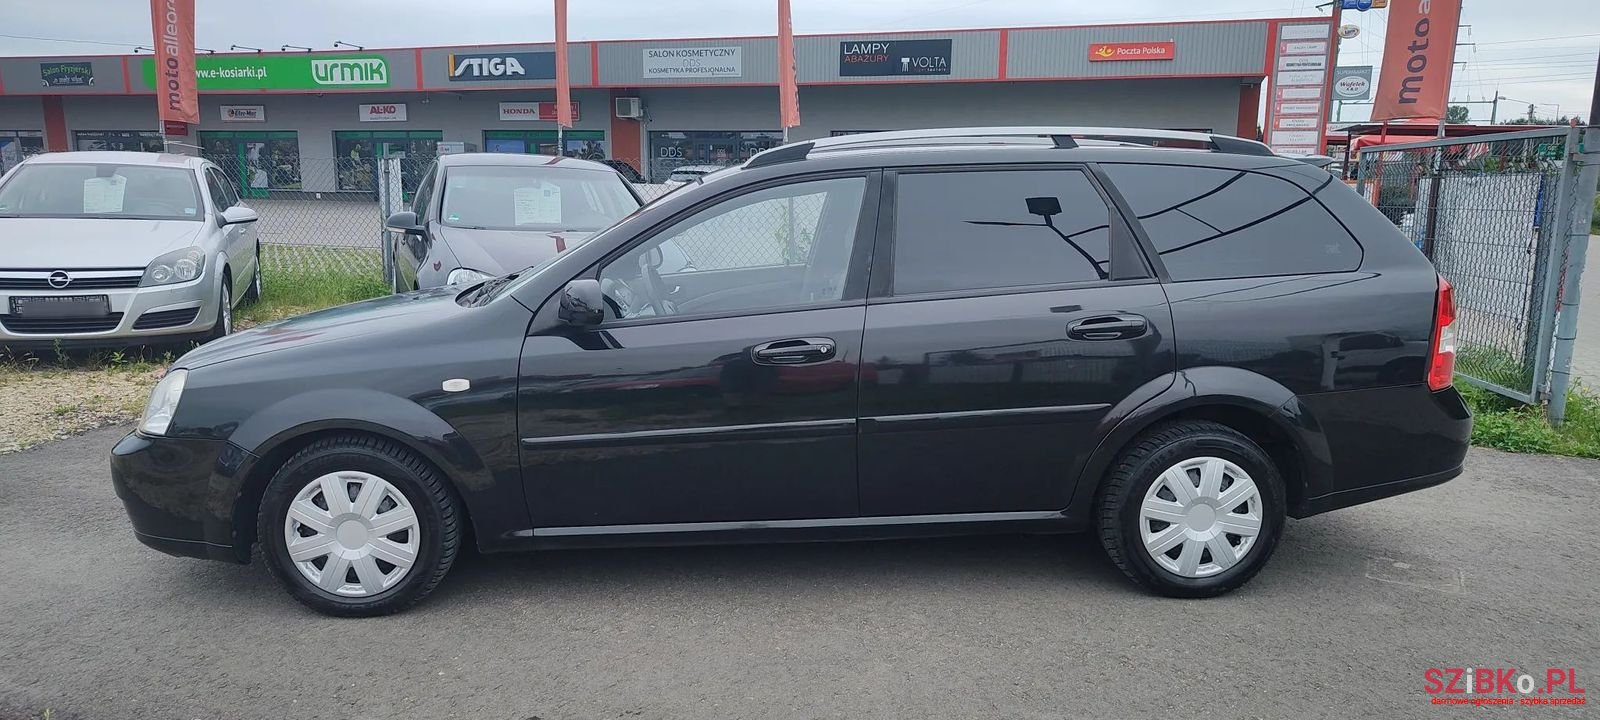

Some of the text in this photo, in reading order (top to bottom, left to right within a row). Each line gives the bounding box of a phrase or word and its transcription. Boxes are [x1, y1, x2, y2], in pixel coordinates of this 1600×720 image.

[648, 48, 736, 58] SALON KOSMETYCZNY
[844, 43, 890, 54] LAMPY
[455, 57, 525, 77] STIGA
[912, 57, 947, 67] VOLTA
[660, 147, 682, 158] DDS
